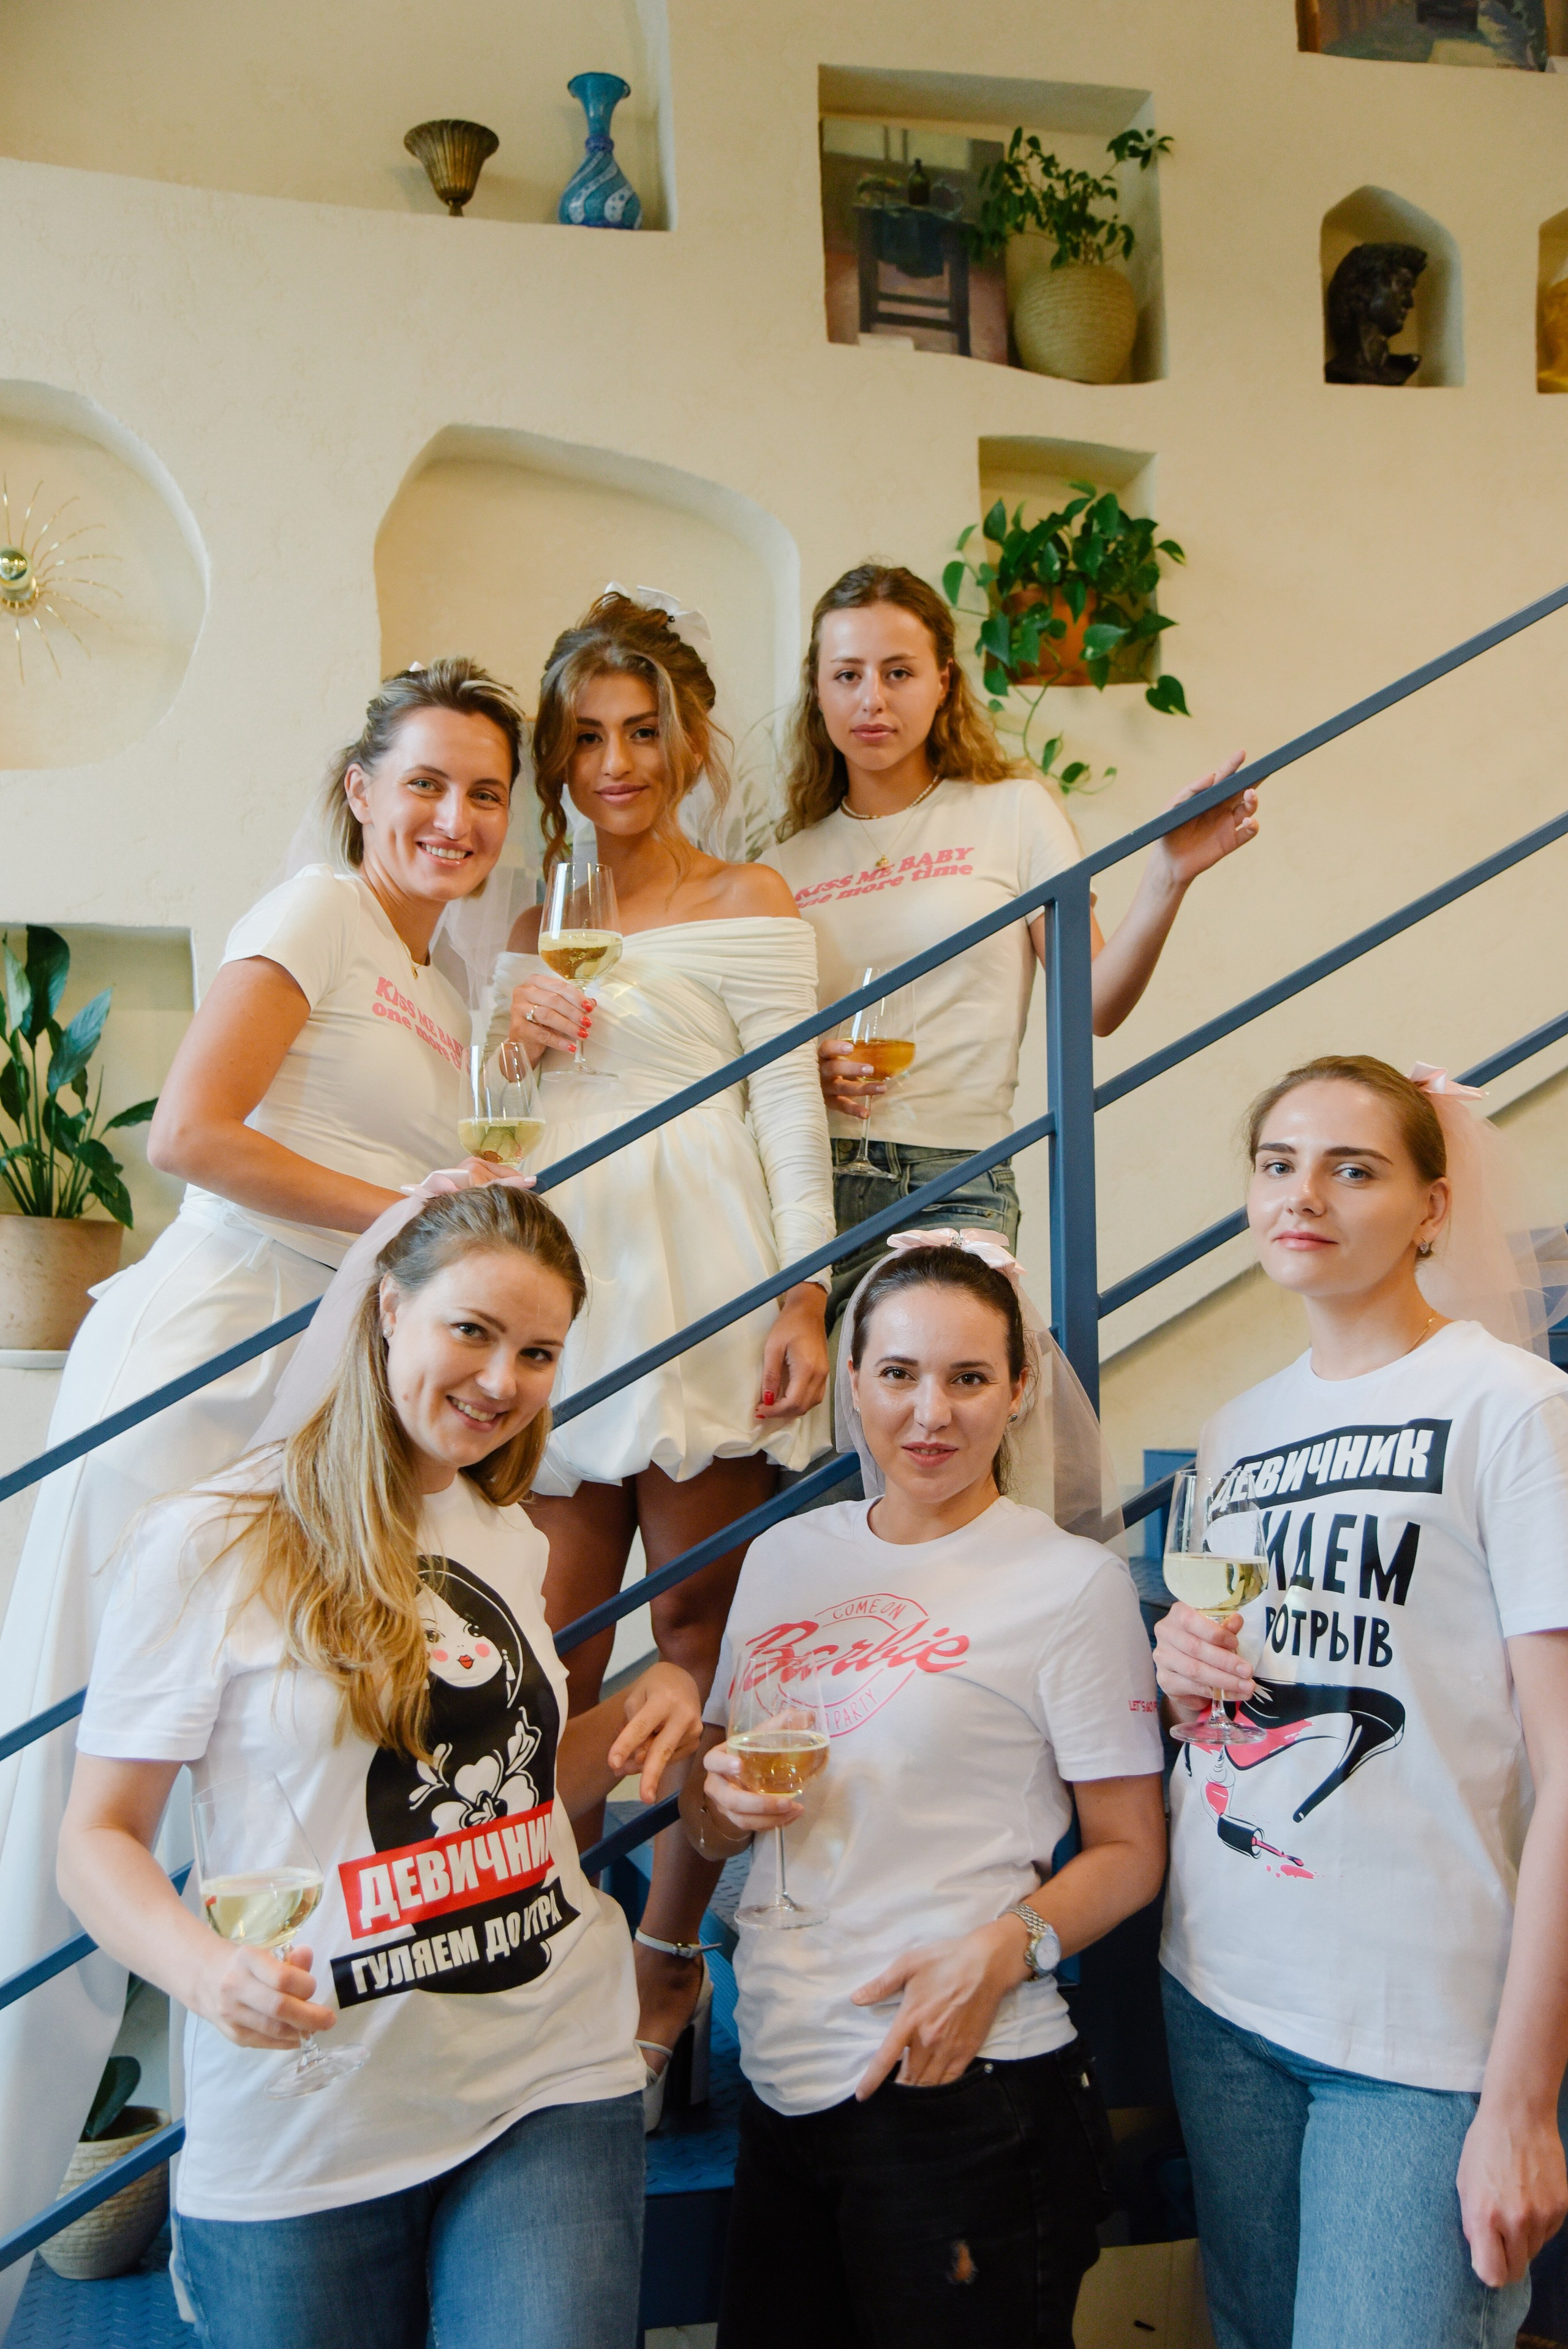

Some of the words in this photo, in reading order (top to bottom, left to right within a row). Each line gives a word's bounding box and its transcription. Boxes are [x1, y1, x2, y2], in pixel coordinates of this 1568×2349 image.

[795, 875, 853, 902] KISS
[856, 865, 895, 884] ME
[897, 847, 974, 873] BABY
[835, 875, 904, 900] more
[911, 864, 973, 881] time
[372, 1002, 413, 1030] one
[415, 1024, 450, 1062] more
[375, 976, 417, 1019] KISS
[417, 1008, 437, 1038] ME
[1210, 1428, 1435, 1514] ДЕВИЧНИК
[728, 1618, 970, 1700] Barbie
[1271, 1603, 1393, 1668] ОТРЫВ
[834, 1687, 877, 1730] PARTY
[350, 1925, 480, 1995] ГУЛЯЕМ
[484, 1912, 521, 1963] ДО
